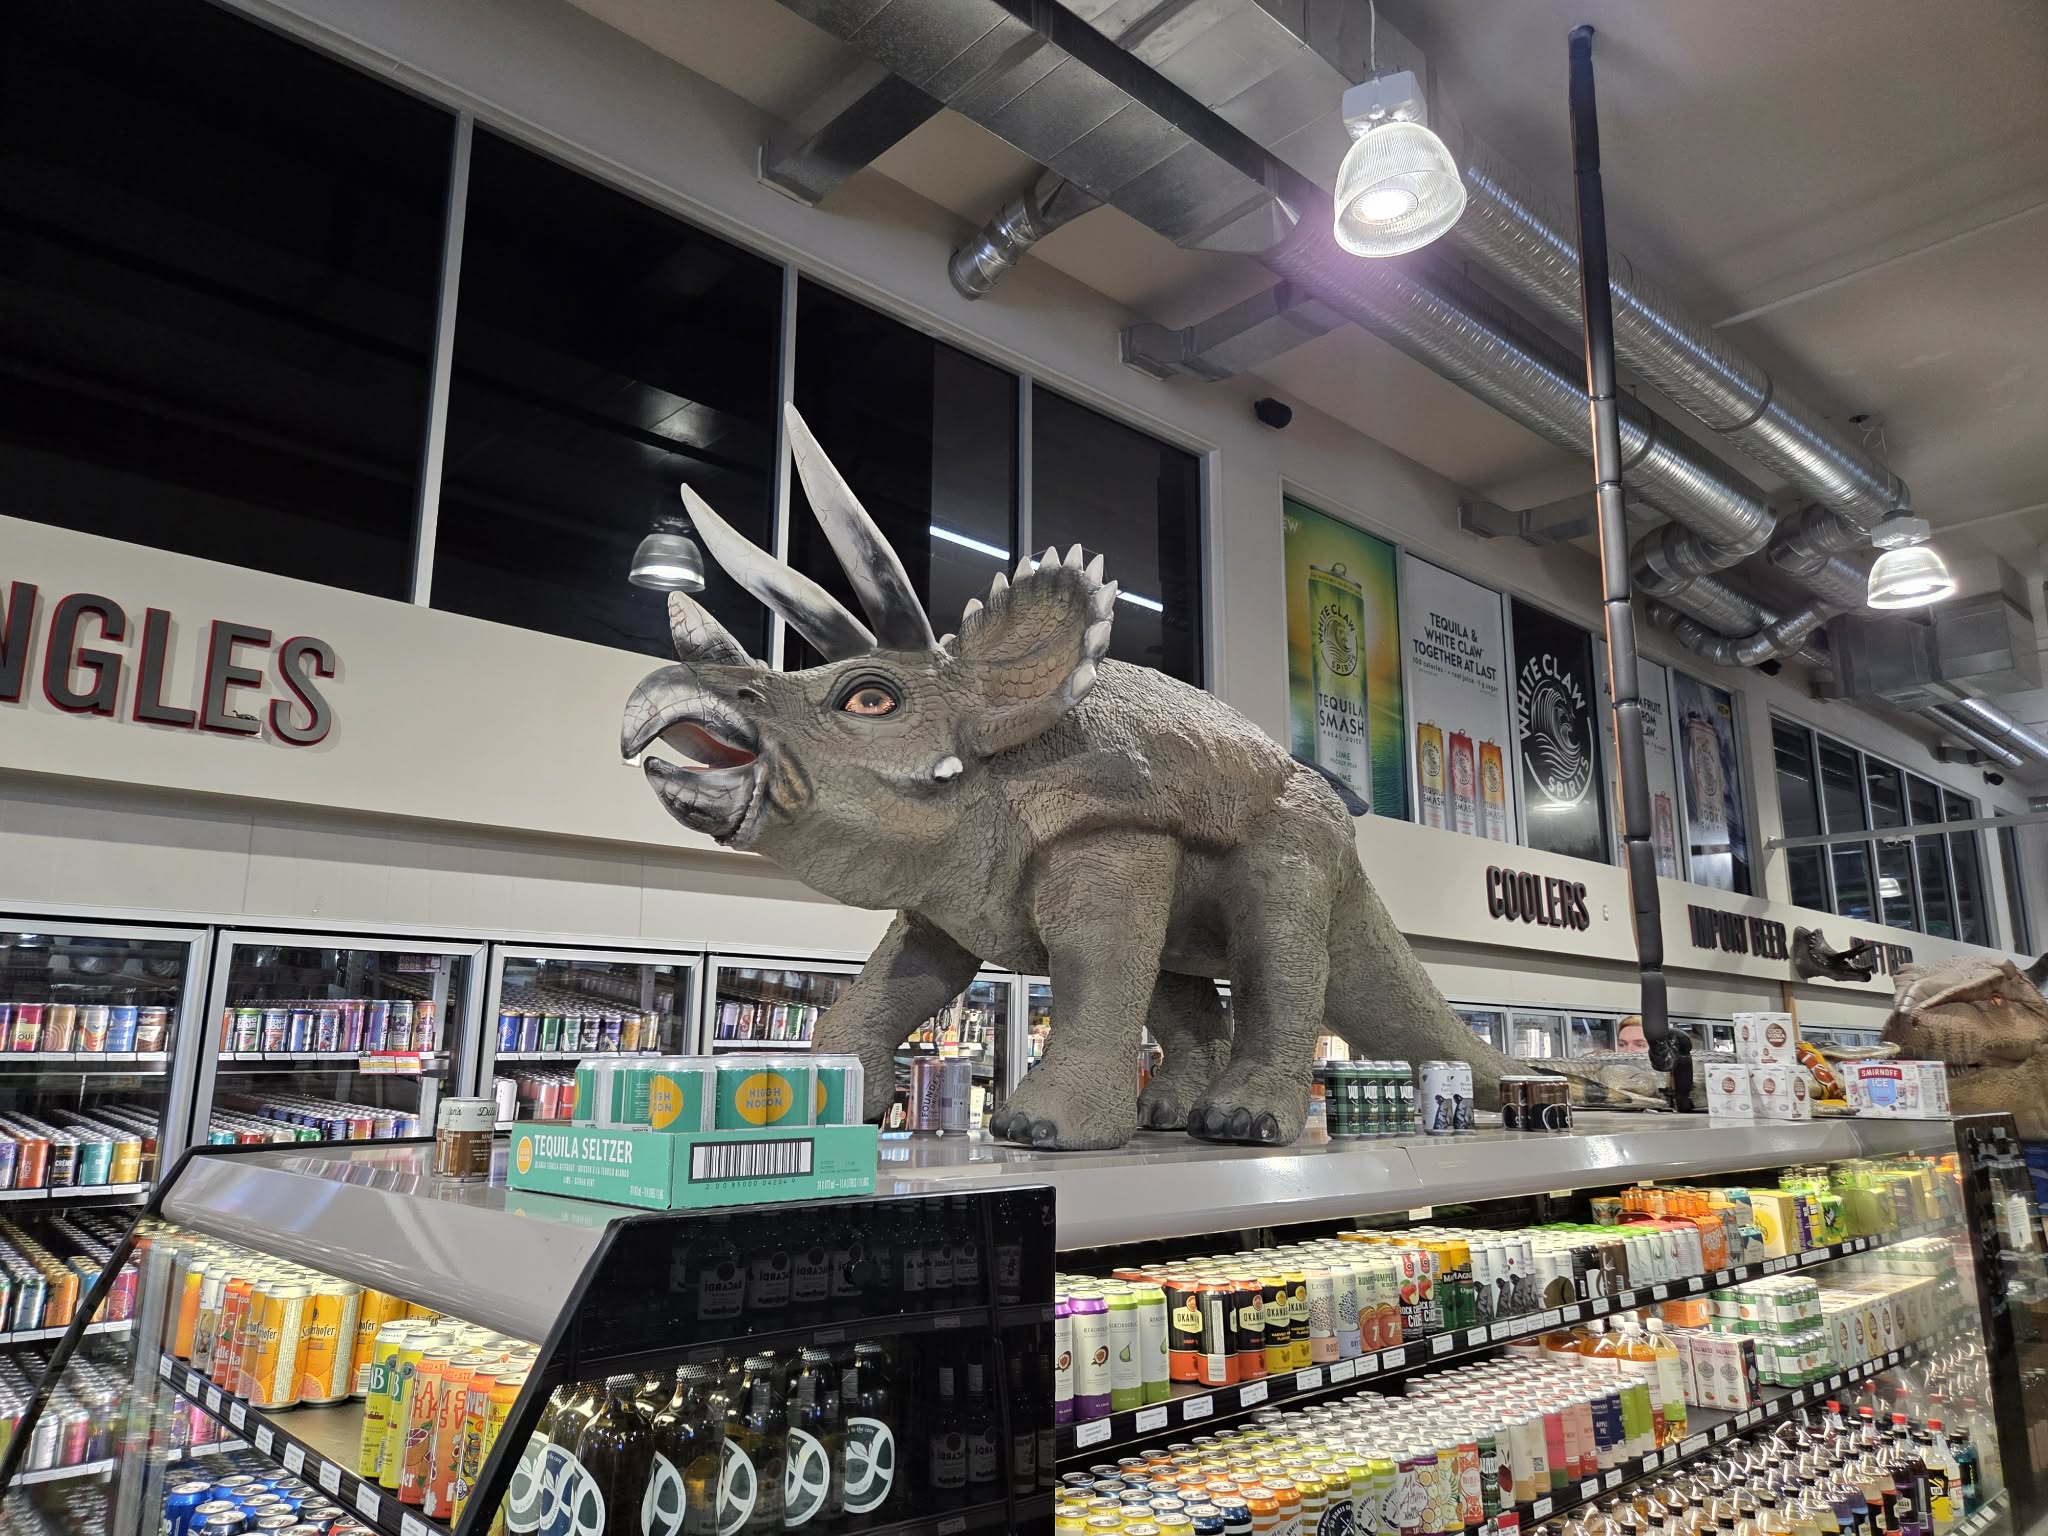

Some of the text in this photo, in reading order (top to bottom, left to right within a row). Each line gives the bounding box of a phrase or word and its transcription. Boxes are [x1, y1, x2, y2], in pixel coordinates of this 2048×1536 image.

[1318, 604, 1355, 645] WHITE CLAW
[1429, 612, 1478, 643] TEQUILA &
[1424, 626, 1483, 659] WHITE CLAW
[1412, 638, 1496, 681] TOGETHER AT LAST
[1319, 693, 1364, 718] TEQUILA
[1517, 653, 1587, 740] WHITE CLAW
[1319, 710, 1365, 737] SMASH
[1336, 749, 1351, 761] LIME
[1548, 755, 1590, 799] SPIRITS
[1486, 865, 1590, 932] COOLERS
[1687, 903, 1790, 961] IMPORT BEER
[1861, 1068, 1899, 1077] SMIRNOFF
[1871, 1078, 1889, 1087] ICE
[534, 1134, 633, 1164] TEQUILA SELTZER
